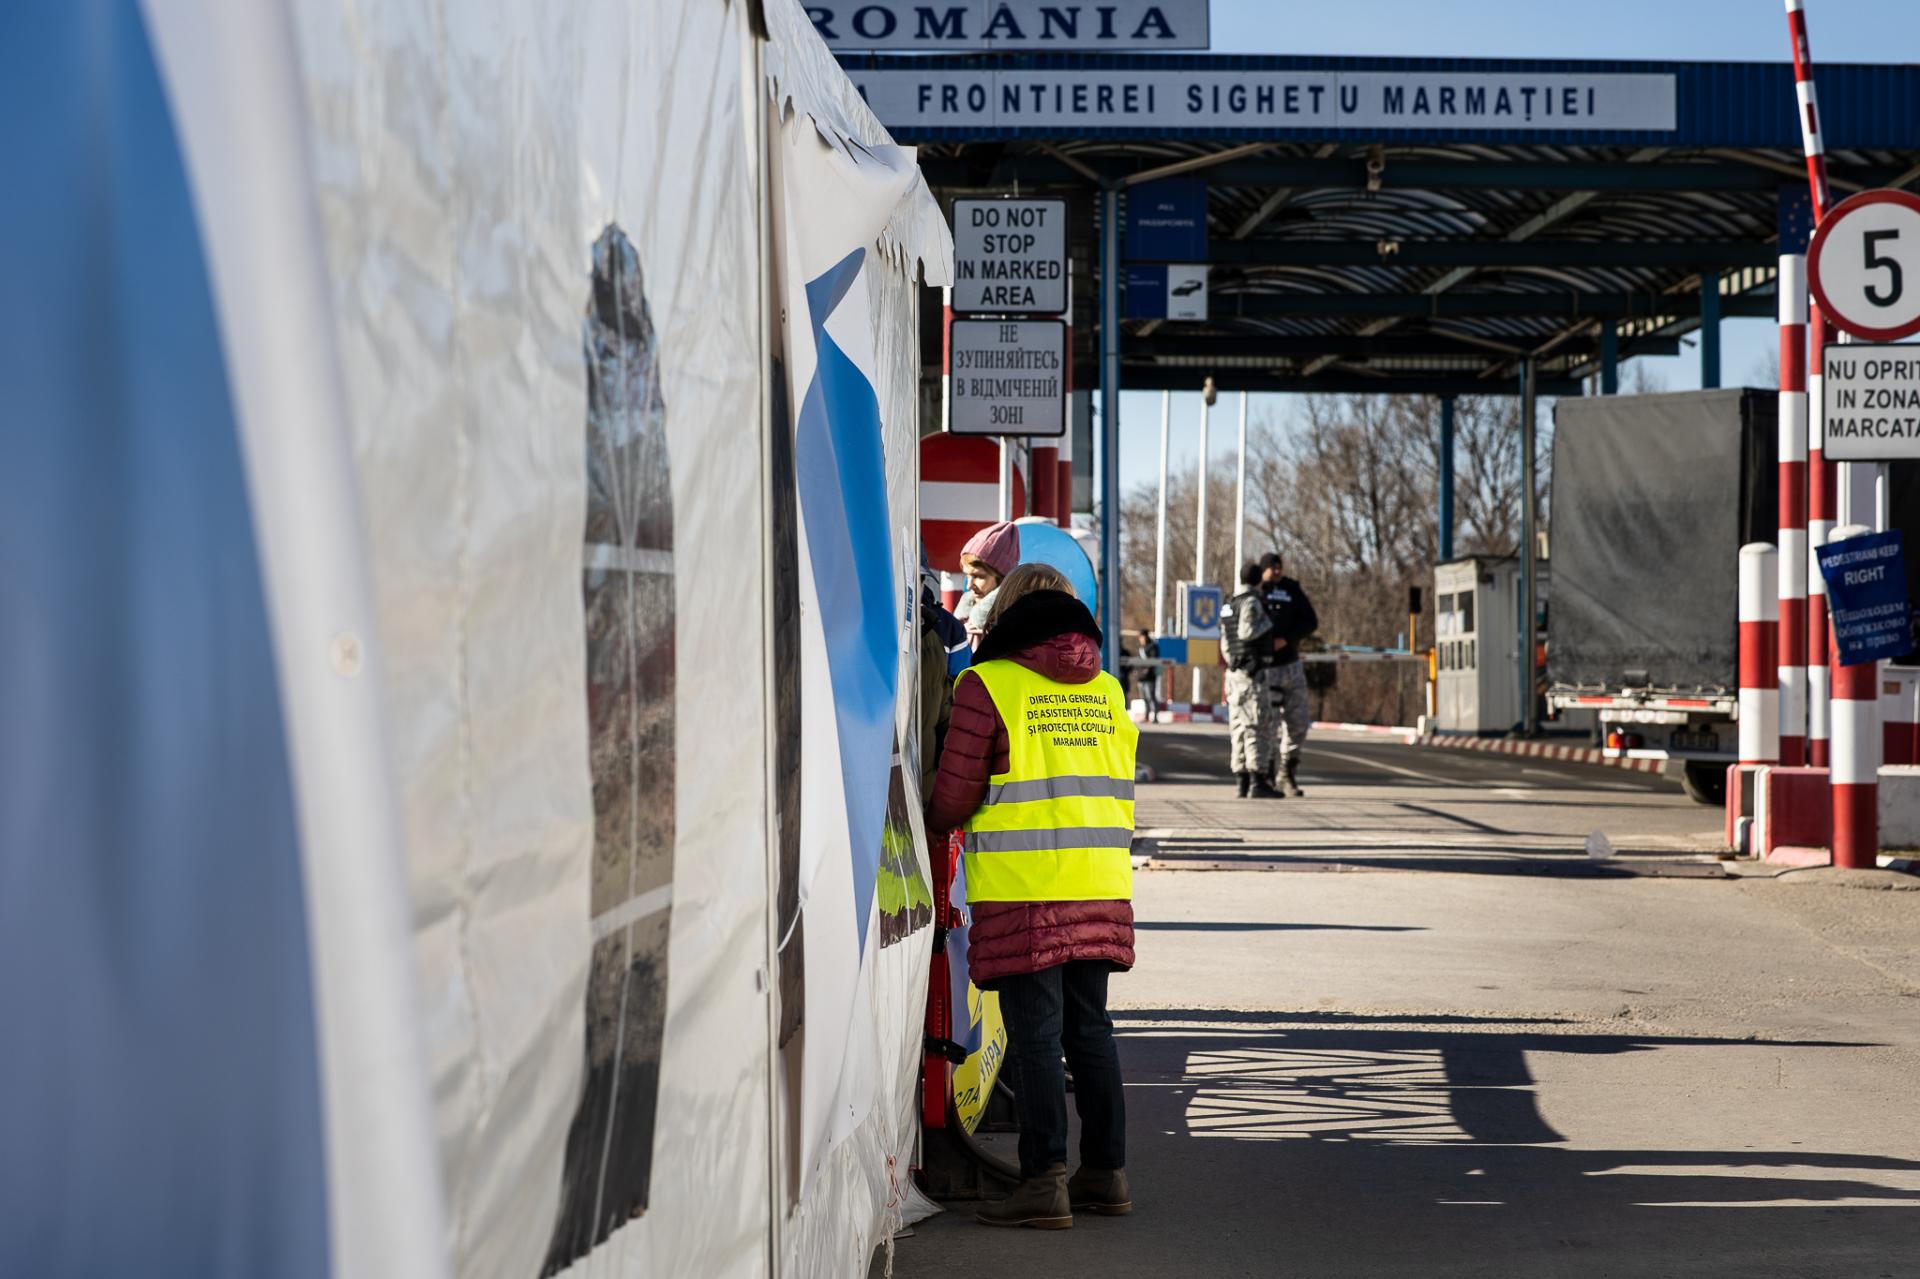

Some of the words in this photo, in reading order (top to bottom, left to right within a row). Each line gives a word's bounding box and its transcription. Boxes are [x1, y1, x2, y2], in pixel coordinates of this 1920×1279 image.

[917, 83, 1155, 114] FRONTIEREI
[972, 208, 1000, 228] DO
[1007, 208, 1047, 228] NOT
[983, 234, 1035, 254] STOP
[957, 260, 975, 280] IN
[981, 260, 1061, 280] MARKED
[1863, 229, 1903, 308] 5
[980, 286, 1036, 306] AREA
[1000, 325, 1018, 343] НЕ
[956, 348, 1059, 370] ЗУПИНЯЙТЕСЬ
[1828, 361, 1857, 380] NU
[957, 378, 965, 396] В
[971, 376, 1058, 400] ВІДМІЧЕНІЙ
[1837, 389, 1856, 409] IN
[1863, 389, 1920, 409] ZONA
[990, 406, 1023, 425] ЗОНІ
[1879, 544, 1899, 557] KEEP
[1844, 566, 1885, 586] RIGHT
[1029, 695, 1067, 705] DIRECȚIA
[1069, 694, 1107, 705] GENERALĂ
[1027, 710, 1039, 720] DE
[1040, 707, 1082, 720] ASISTENȚĂ
[1028, 725, 1036, 737] ȘI
[1038, 723, 1079, 734] PROTECȚIA
